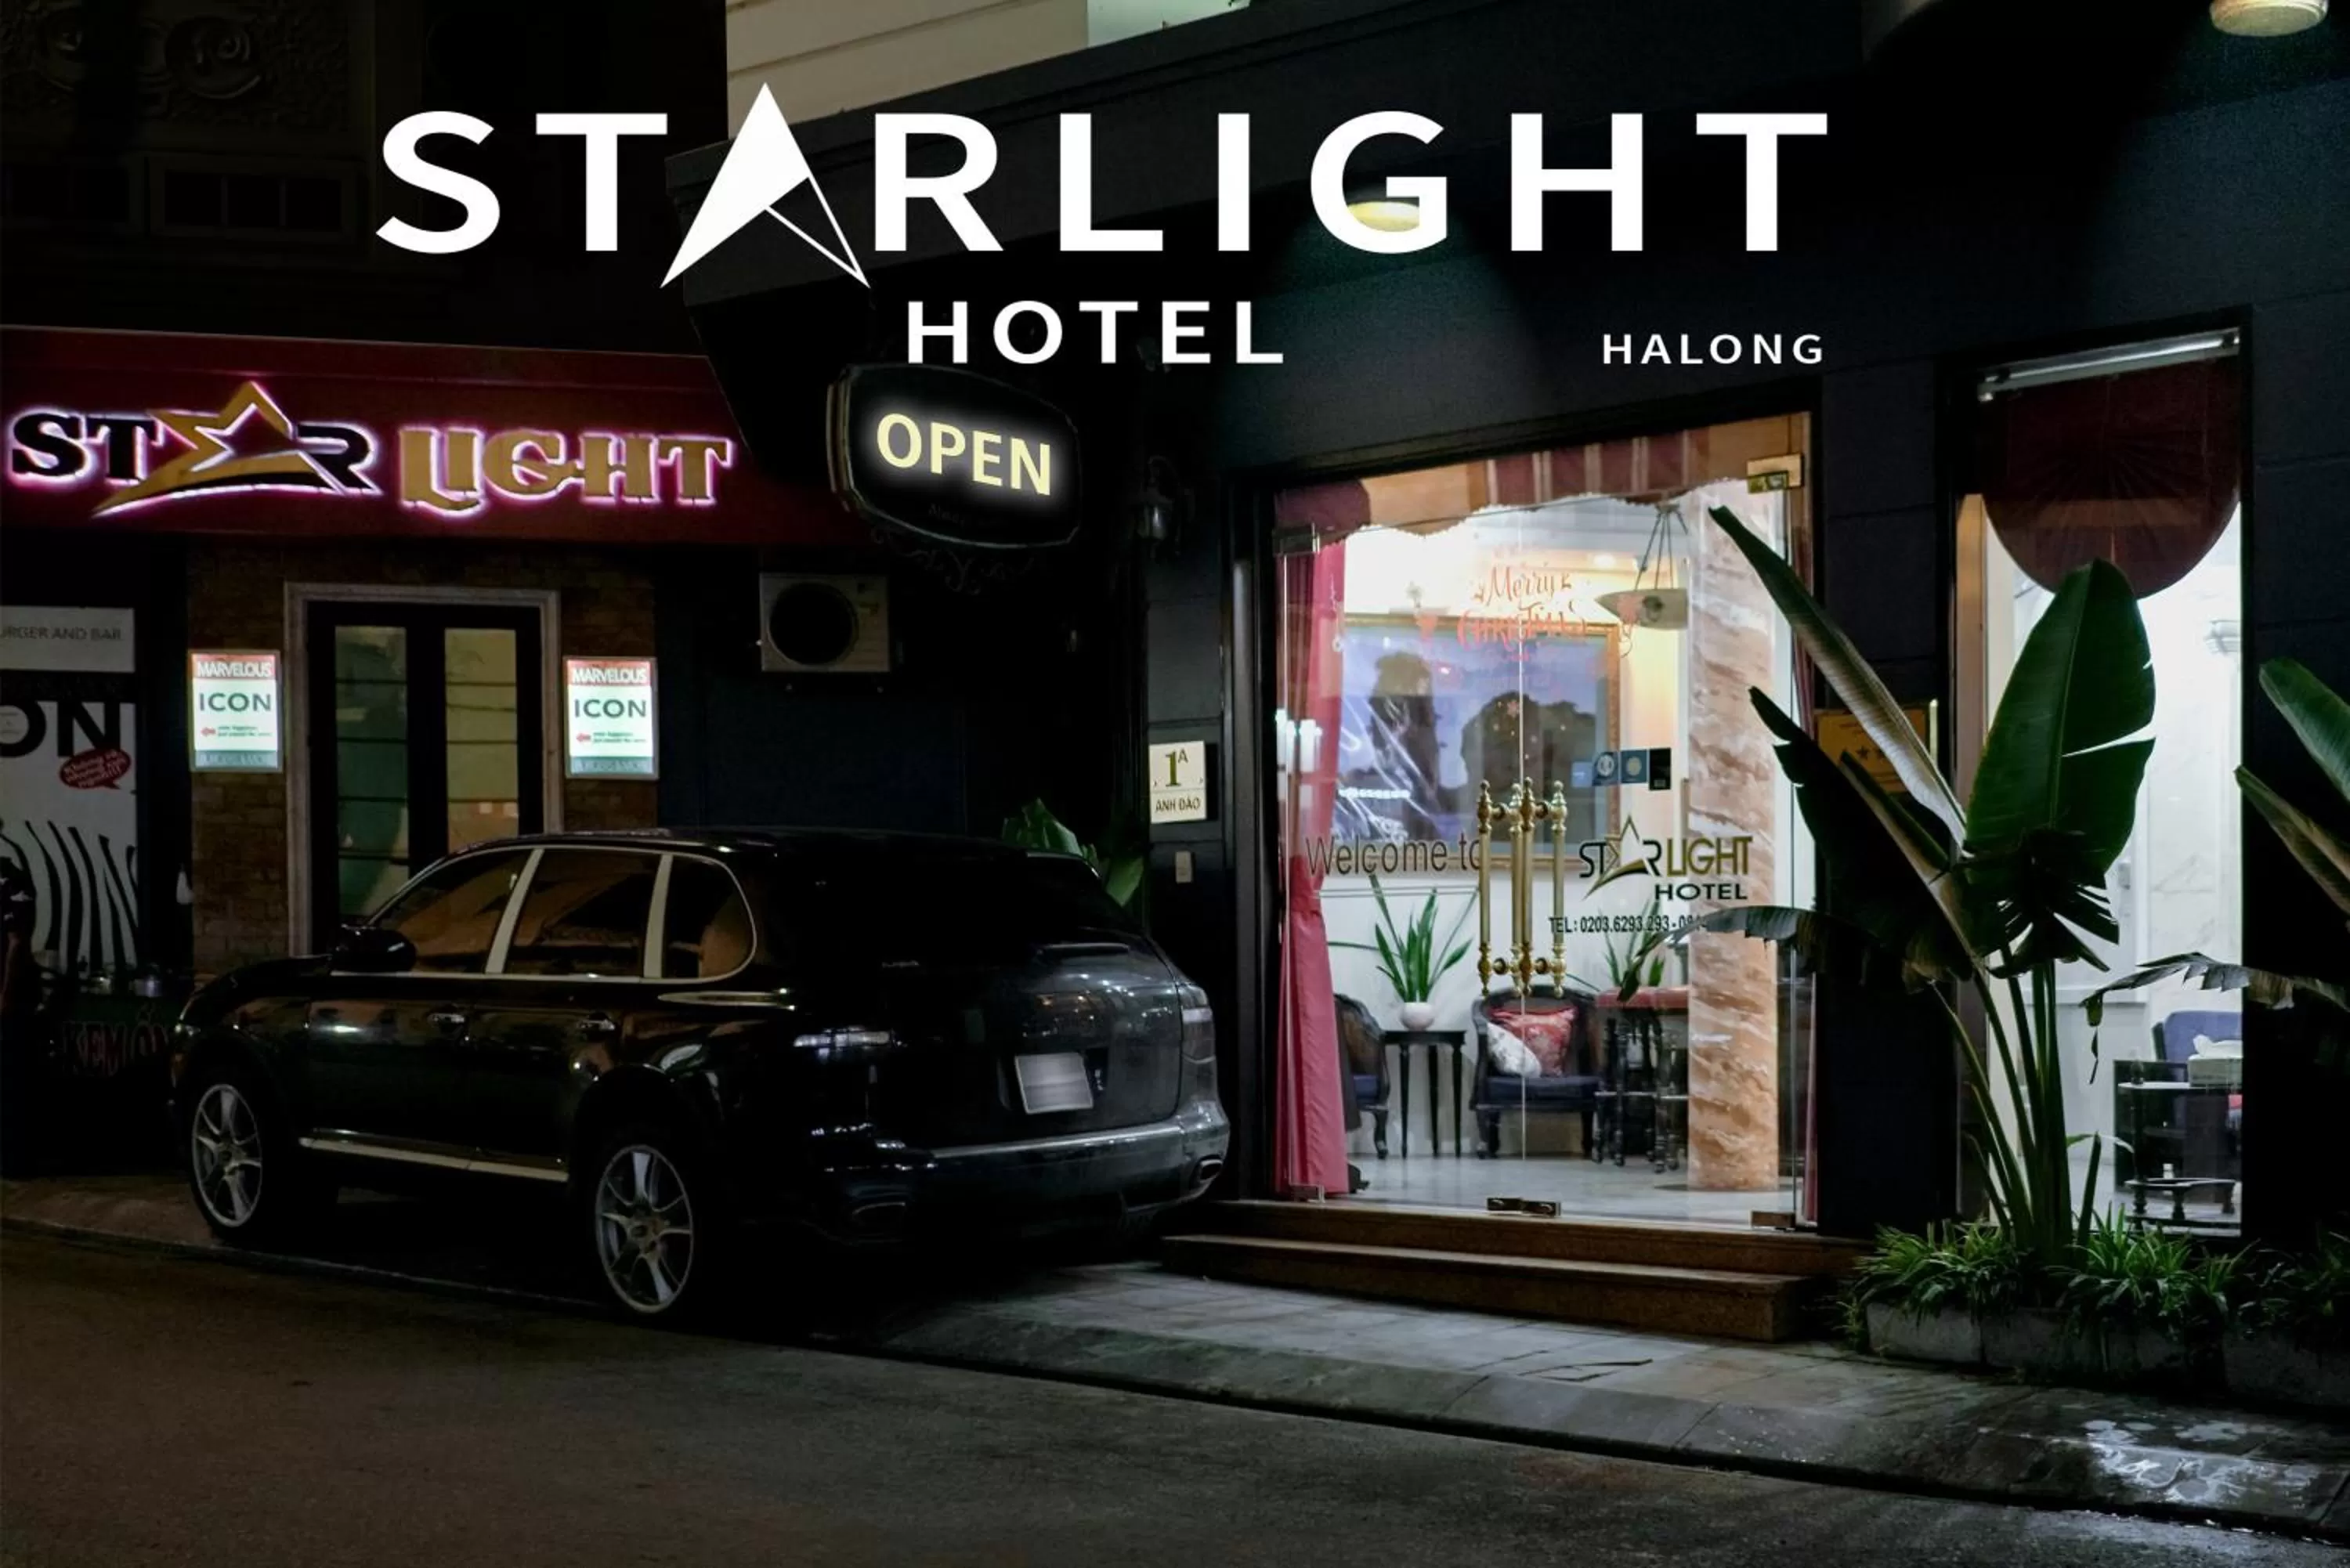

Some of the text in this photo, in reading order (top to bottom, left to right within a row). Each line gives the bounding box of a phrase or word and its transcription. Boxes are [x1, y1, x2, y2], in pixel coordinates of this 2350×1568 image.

[877, 413, 1051, 496] OPEN
[52, 627, 88, 640] AND
[90, 627, 122, 641] BAR
[197, 661, 272, 677] MARVELOUS
[573, 667, 647, 684] MARVELOUS
[199, 692, 271, 713] ICON
[574, 698, 647, 718] ICON
[1155, 799, 1176, 811] ANH
[1306, 835, 1448, 876] Welcome
[1654, 883, 1748, 901] HOTEL
